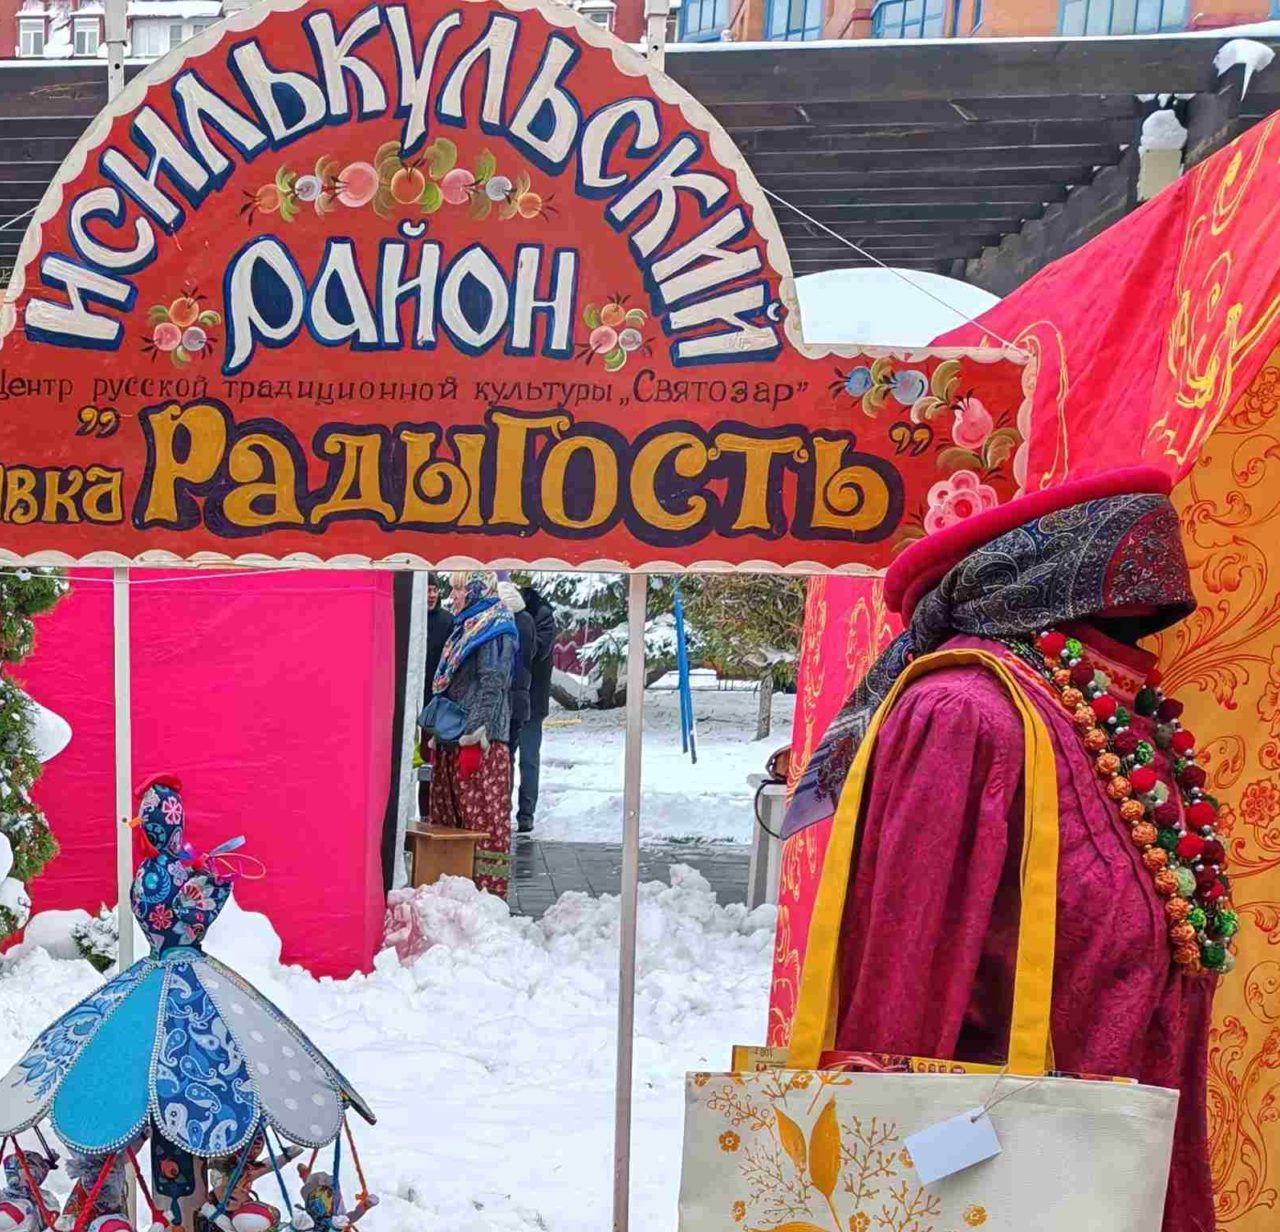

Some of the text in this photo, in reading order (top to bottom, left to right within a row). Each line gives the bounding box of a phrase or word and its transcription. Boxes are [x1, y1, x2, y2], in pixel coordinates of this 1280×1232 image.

[93, 375, 208, 403] русской
[223, 376, 460, 404] традиционной
[474, 377, 613, 406] культуры
